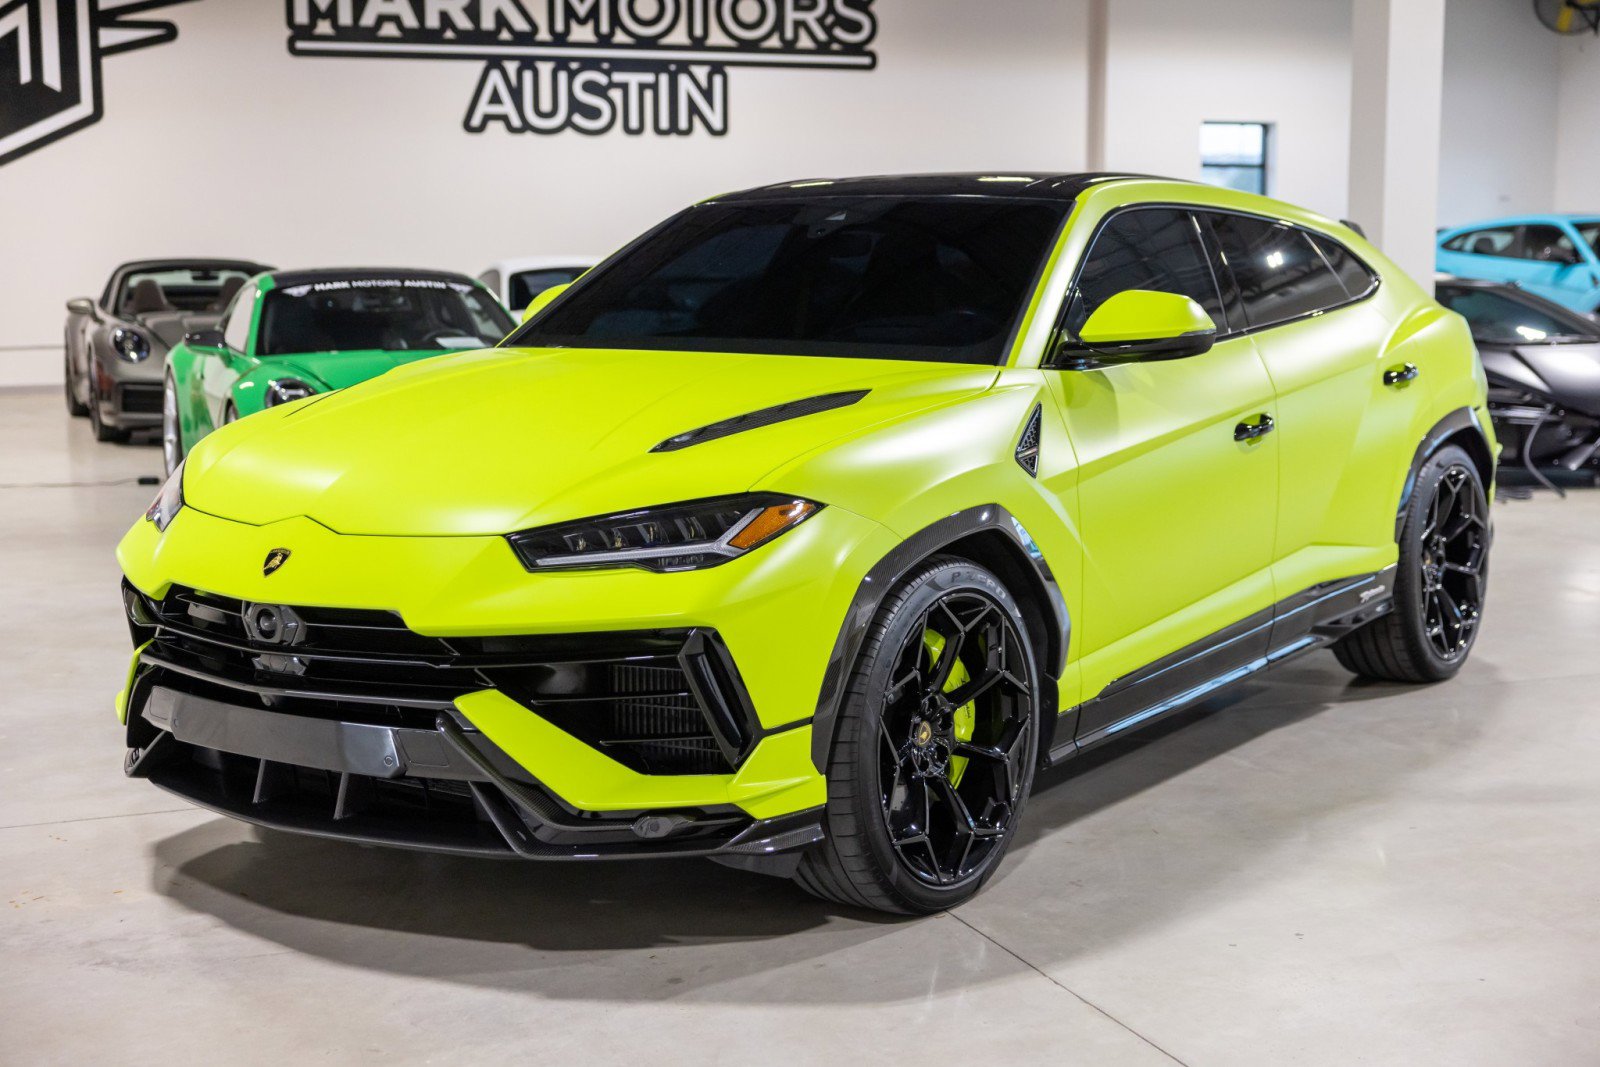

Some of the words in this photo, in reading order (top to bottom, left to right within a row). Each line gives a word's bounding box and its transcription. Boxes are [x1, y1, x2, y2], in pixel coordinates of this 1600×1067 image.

[468, 68, 725, 132] AUSTIN
[313, 281, 350, 291] MARK
[352, 279, 402, 288] MOTORS
[404, 279, 446, 289] AUSTIN
